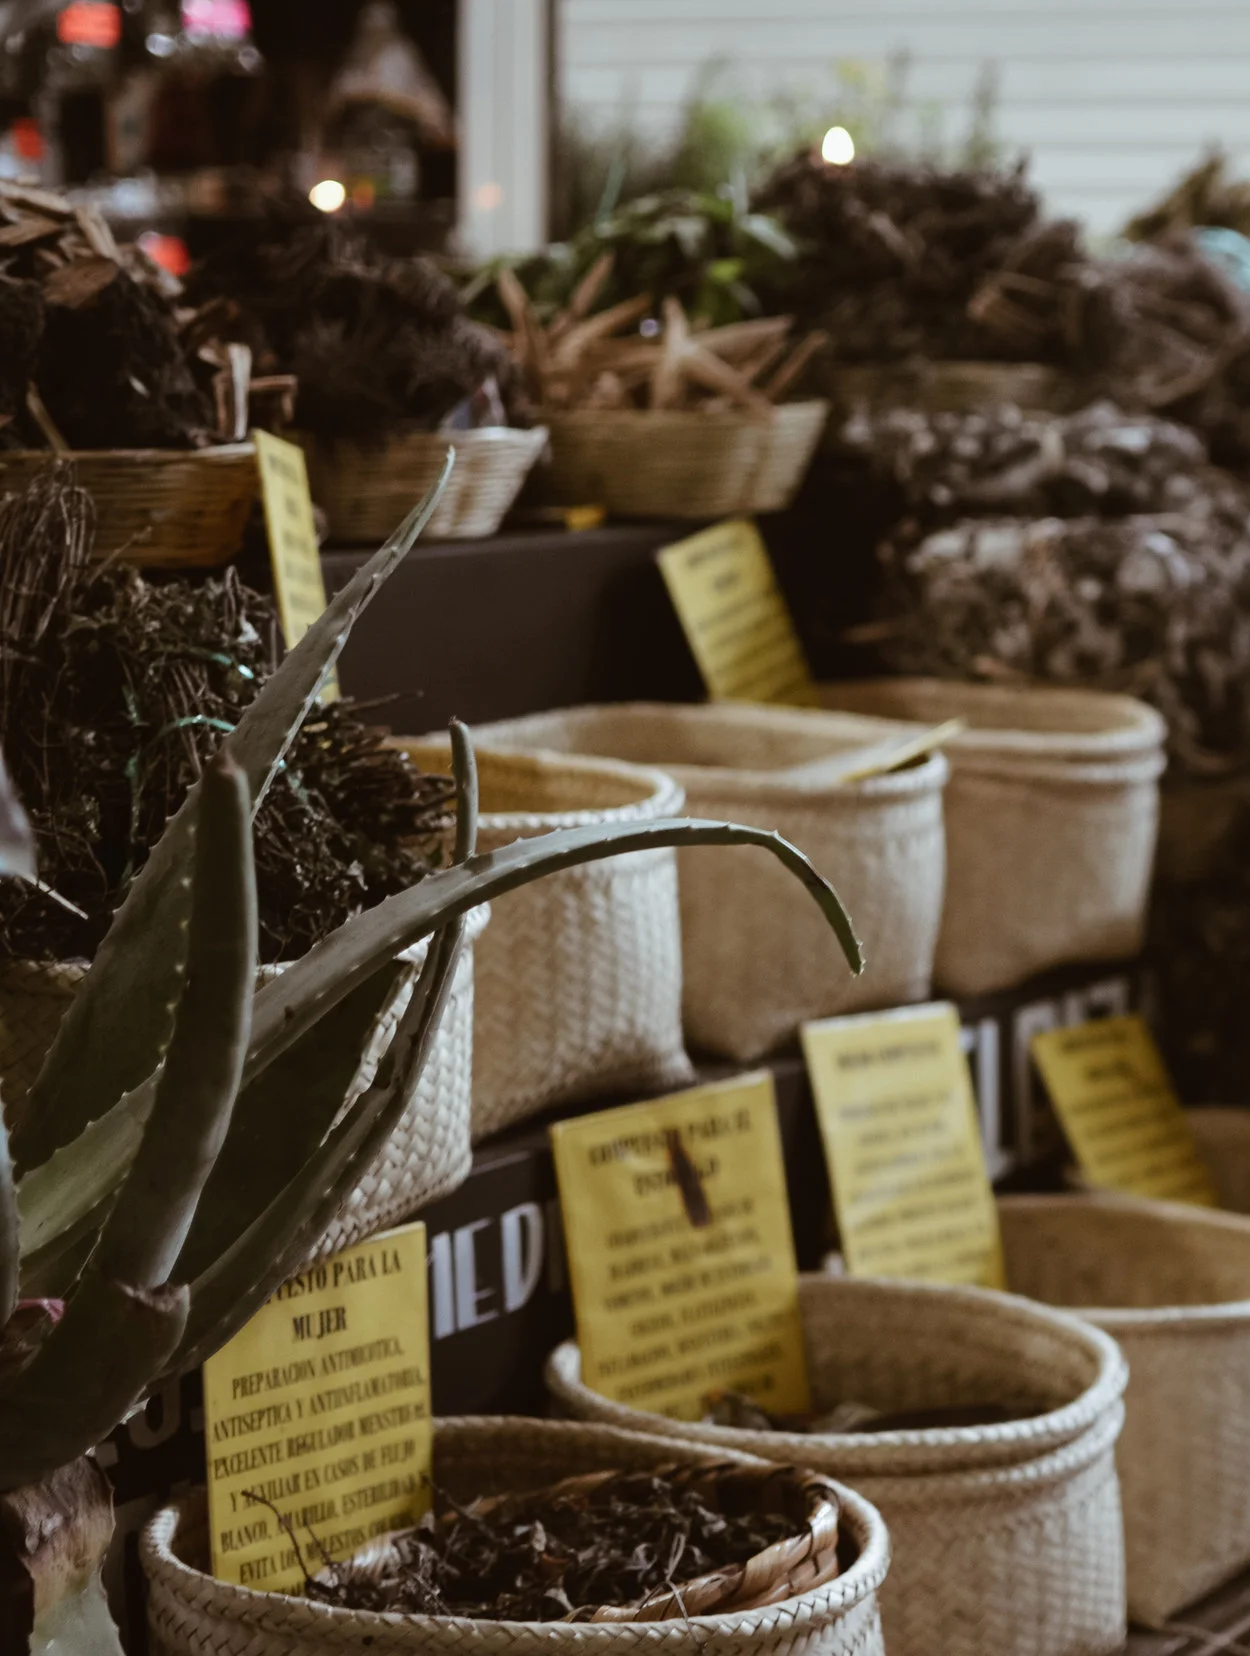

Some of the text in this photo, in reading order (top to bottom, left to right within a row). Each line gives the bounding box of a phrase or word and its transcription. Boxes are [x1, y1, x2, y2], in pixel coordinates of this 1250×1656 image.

[333, 1254, 377, 1288] PARA
[382, 1249, 402, 1275] LA
[292, 1305, 347, 1342] MUJER
[232, 1358, 315, 1400] PREPARACION
[212, 1402, 292, 1443] ANTISEPTICA
[295, 1397, 305, 1419] Y
[214, 1439, 284, 1480] EXCELENTE
[286, 1419, 356, 1459] REGULADOR
[229, 1438, 416, 1513] Y AUXILIAR EN CASOS DE FLUJO
[240, 1555, 278, 1585] EVITA
